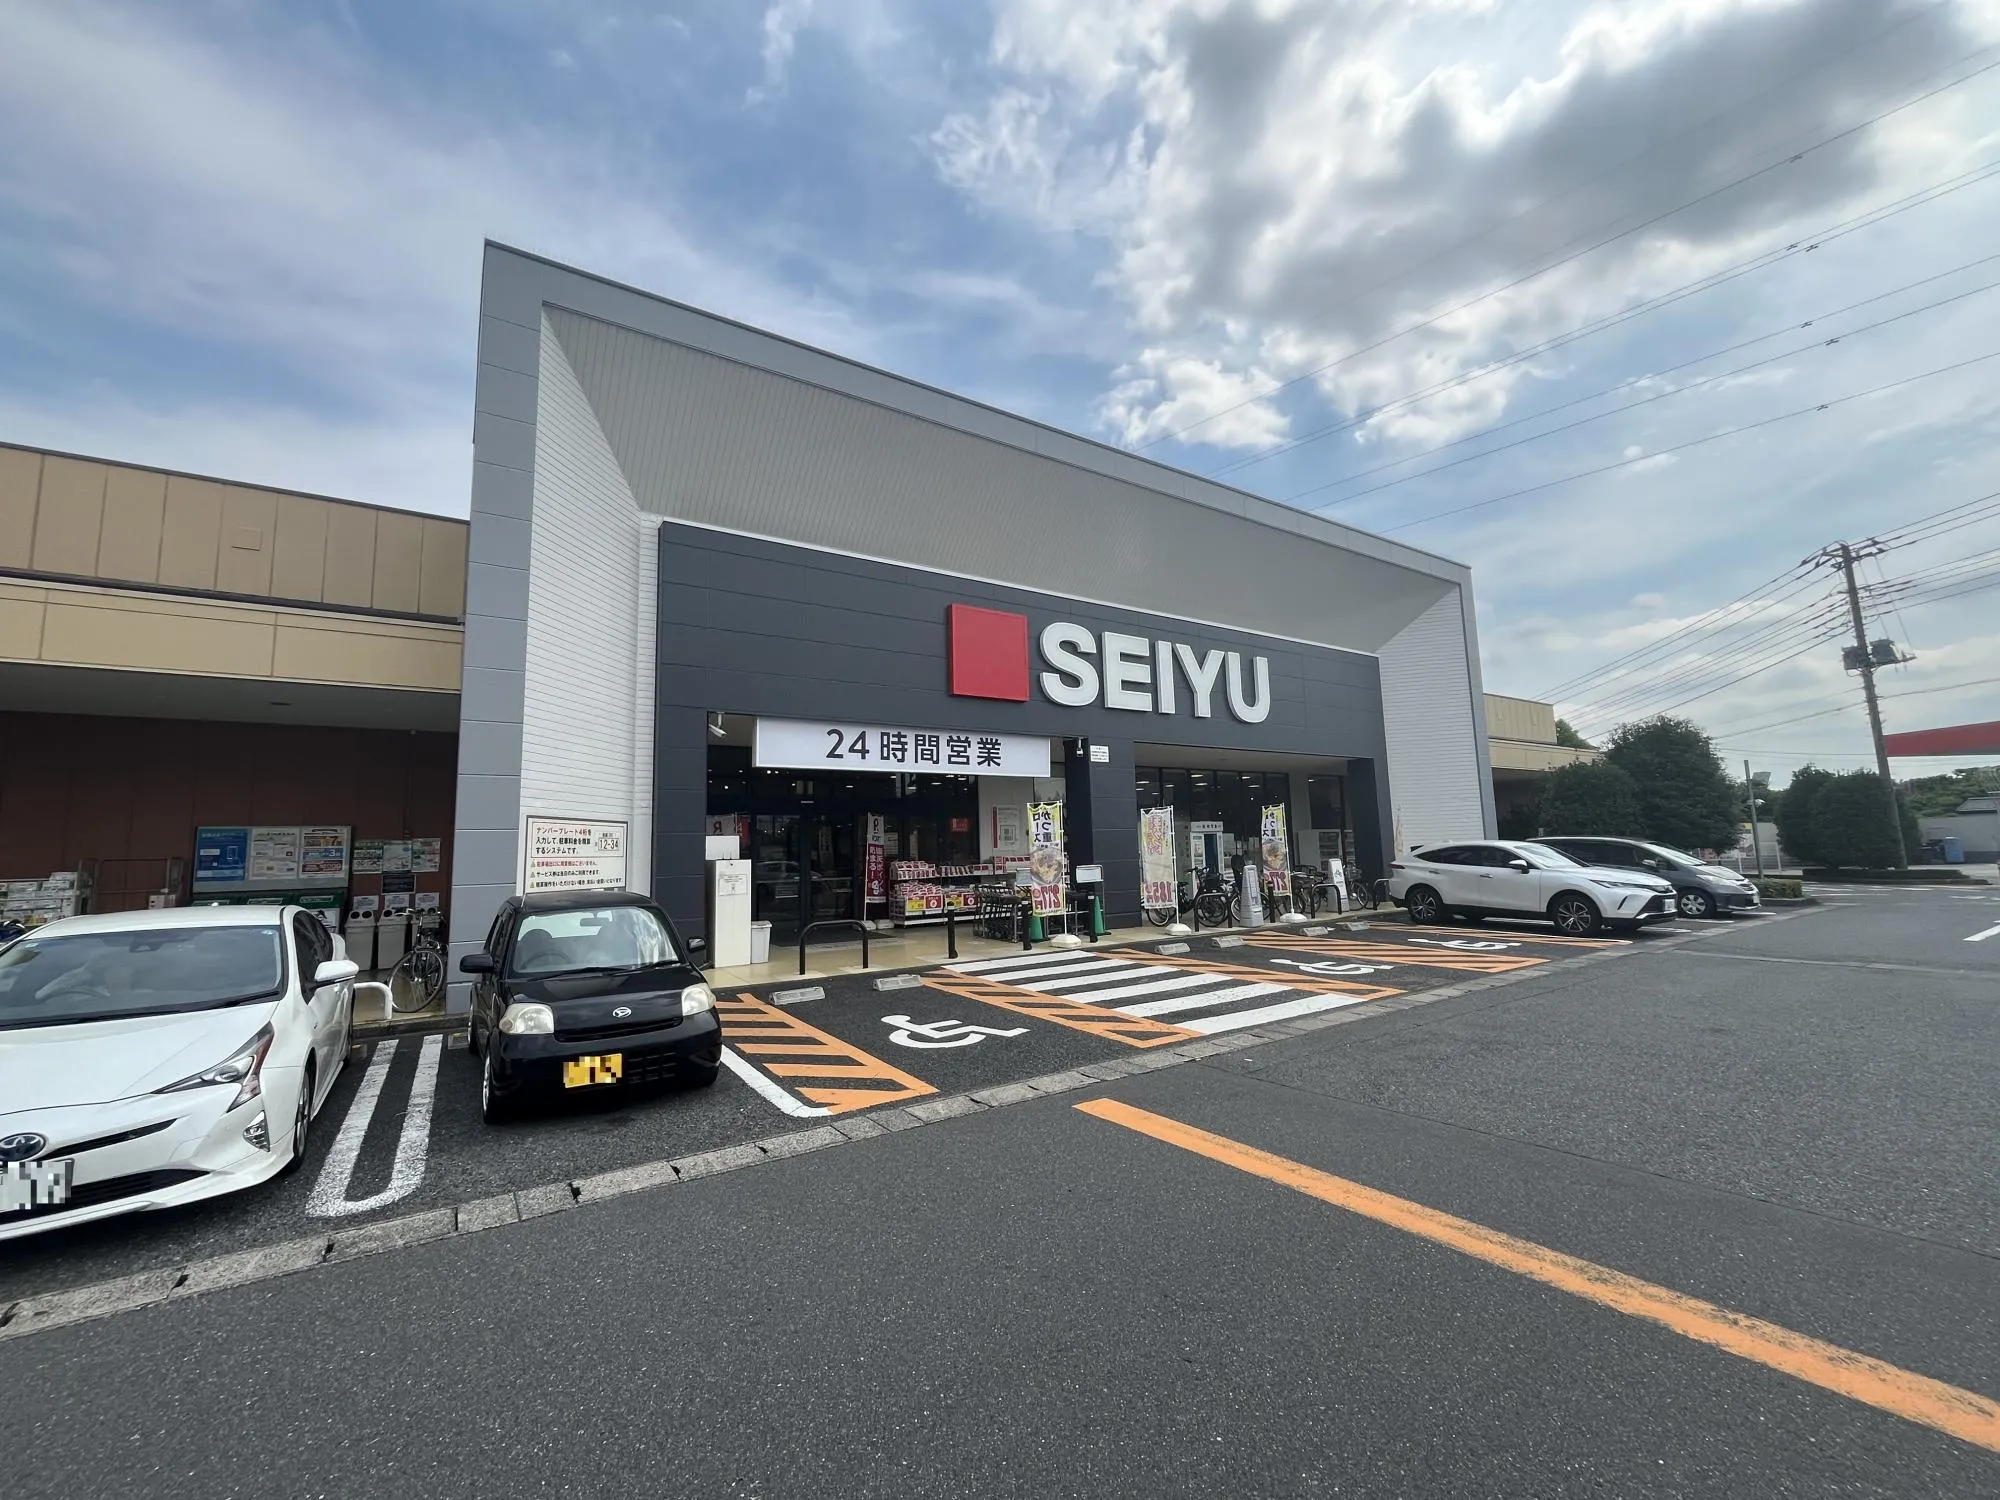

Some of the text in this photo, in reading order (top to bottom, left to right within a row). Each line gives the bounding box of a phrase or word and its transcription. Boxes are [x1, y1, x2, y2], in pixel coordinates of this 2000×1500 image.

[1040, 622, 1271, 723] SEIYU
[825, 728, 1002, 767] 24時間営業
[536, 826, 592, 837] ナンバープレート4桁を
[599, 839, 619, 850] 12-34
